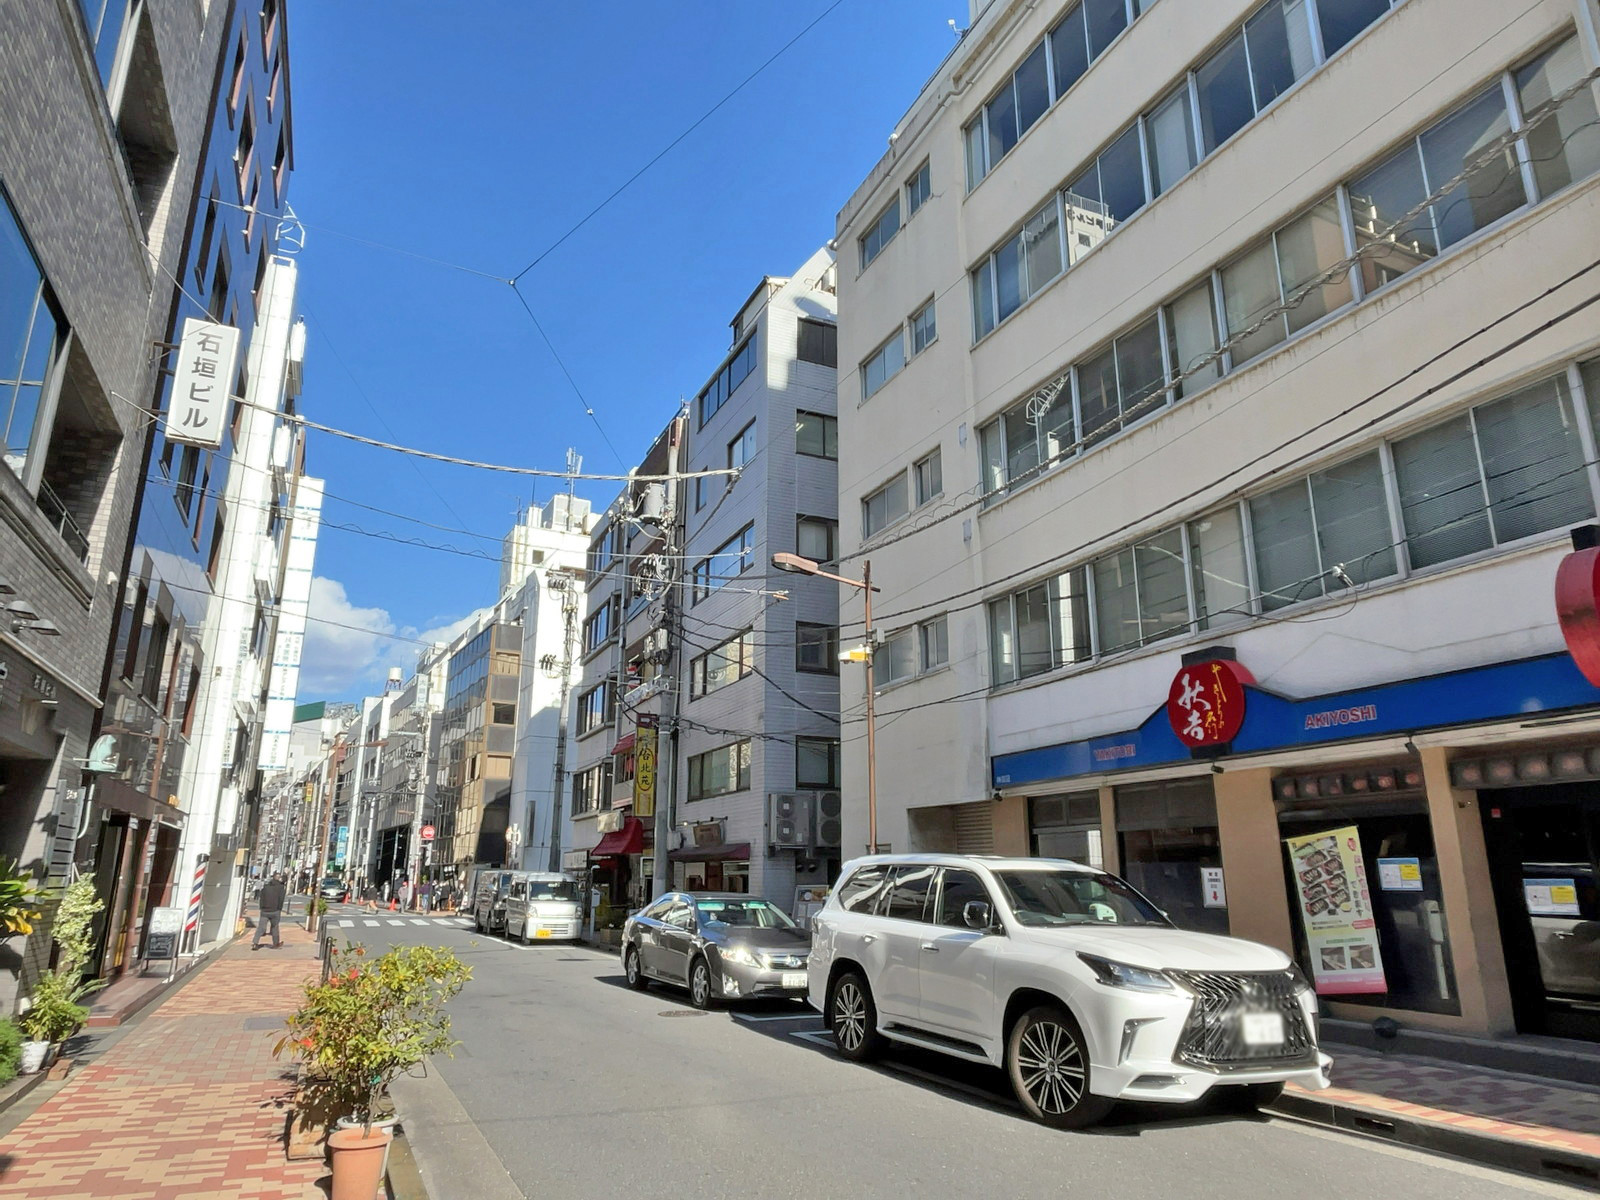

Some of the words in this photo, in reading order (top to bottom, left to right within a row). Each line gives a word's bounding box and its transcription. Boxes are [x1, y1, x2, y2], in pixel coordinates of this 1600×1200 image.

[183, 332, 223, 428] 石垣ビル
[1178, 673, 1211, 740] 秋吉
[1305, 705, 1376, 729] AKIYOSHI
[1094, 744, 1136, 761] YAKITORI
